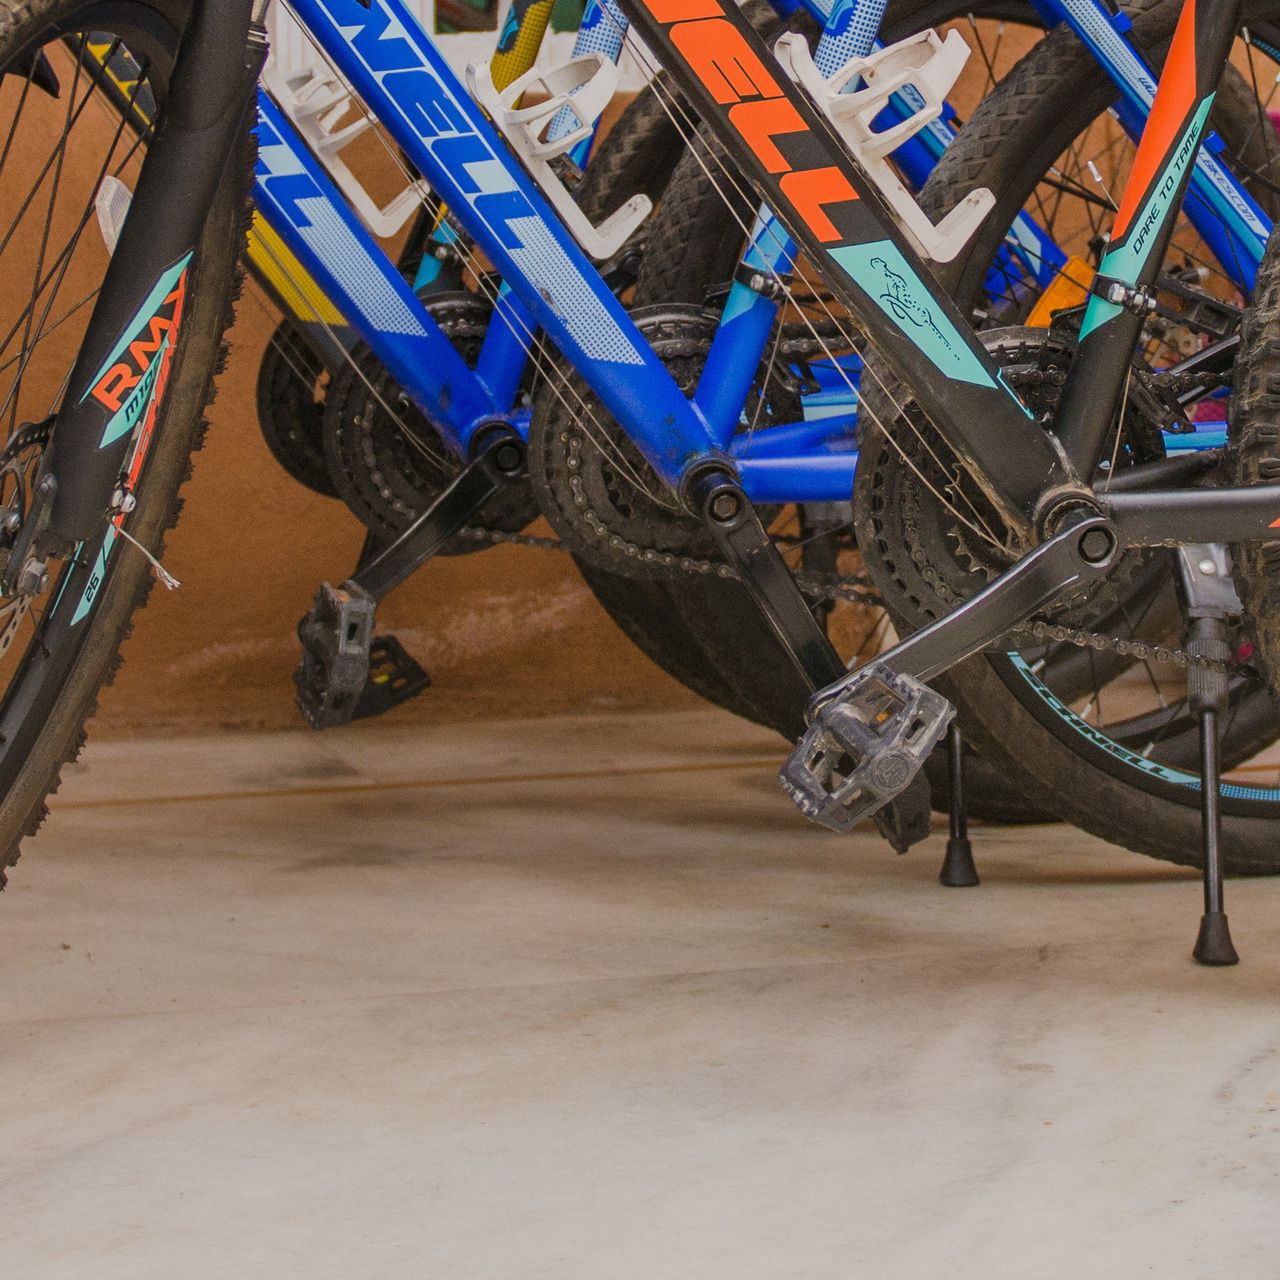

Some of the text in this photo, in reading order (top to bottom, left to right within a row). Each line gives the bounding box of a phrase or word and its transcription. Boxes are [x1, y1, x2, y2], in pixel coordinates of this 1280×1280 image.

[1133, 121, 1200, 256] DARE TO TAME
[1020, 667, 1170, 780] SCHNELL
